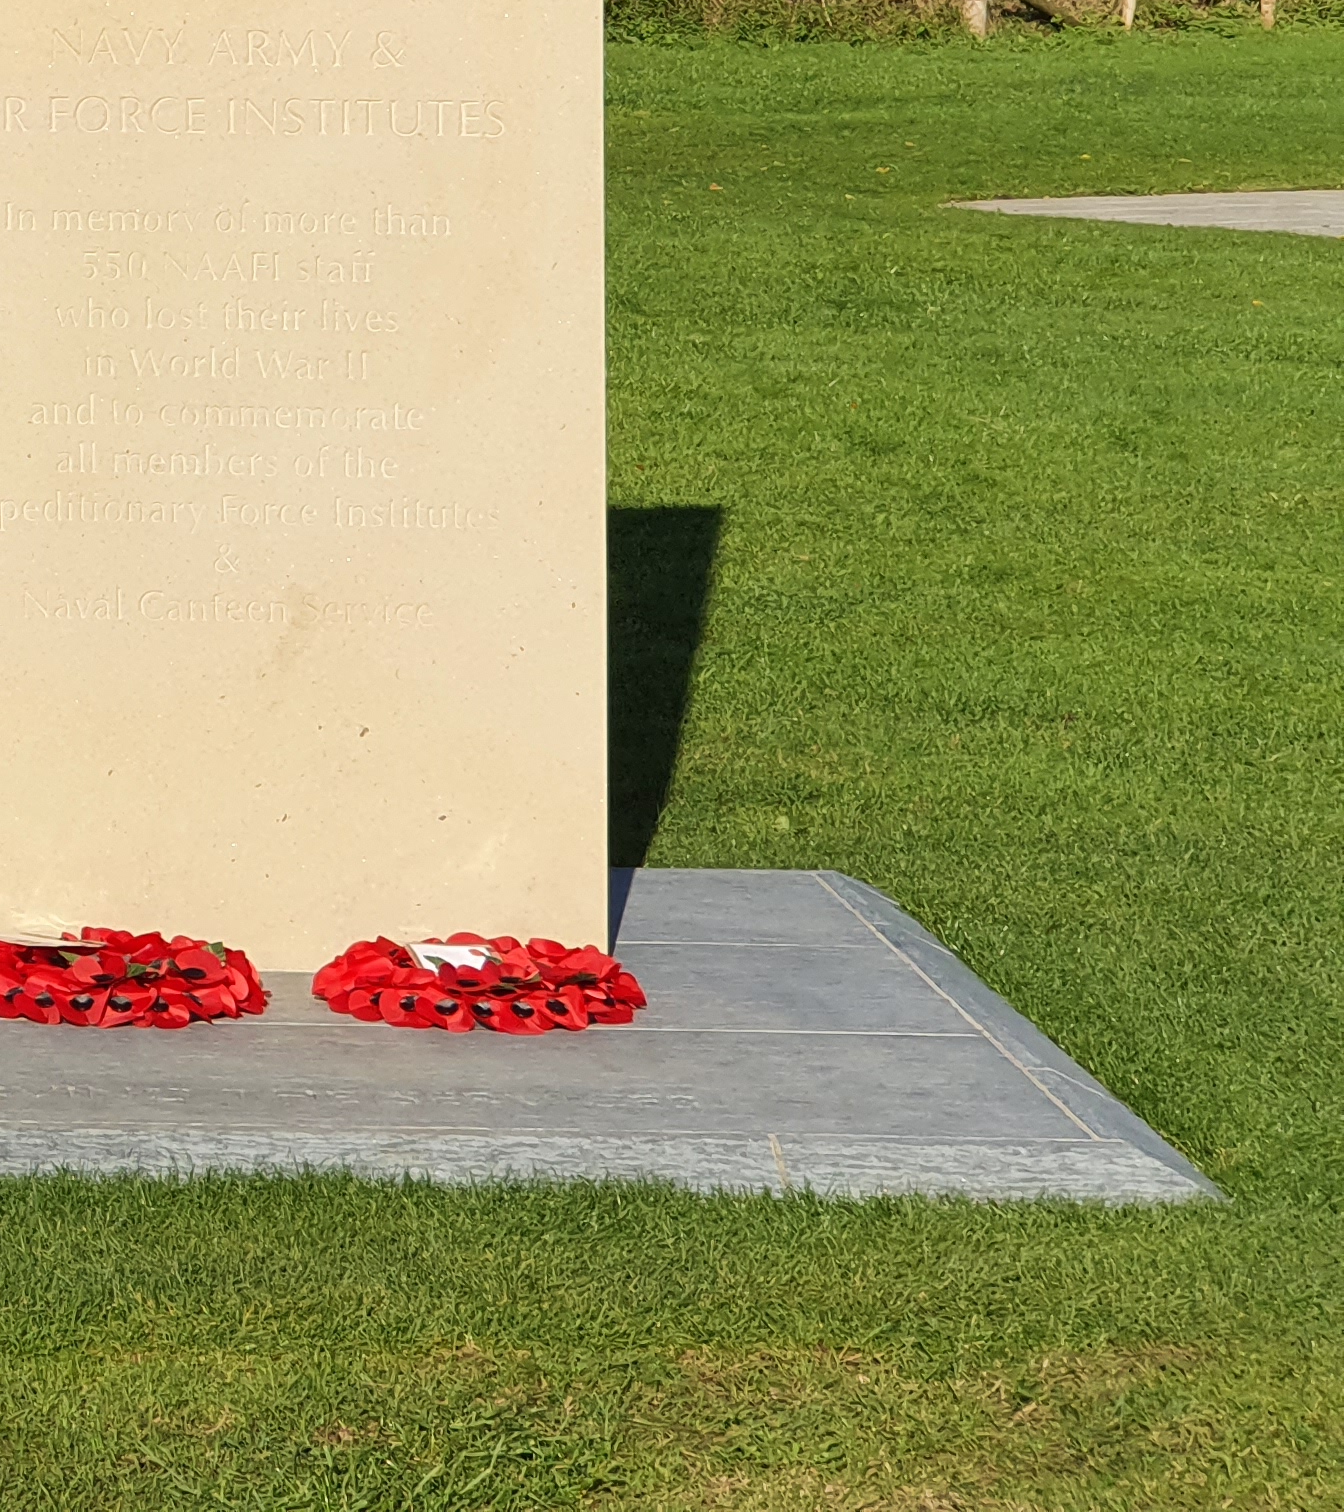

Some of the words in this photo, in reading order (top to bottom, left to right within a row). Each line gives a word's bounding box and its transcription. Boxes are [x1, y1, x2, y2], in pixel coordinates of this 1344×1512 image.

[50, 27, 185, 68] NAVY
[208, 28, 352, 69] ARMY
[370, 29, 405, 69] &
[48, 95, 208, 136] FORCE
[227, 97, 508, 139] INSTITUTES
[3, 200, 38, 233] In
[51, 208, 200, 238] memory
[214, 199, 250, 234] of
[263, 209, 358, 236] more
[372, 203, 452, 238] than
[81, 250, 148, 281] 550
[163, 251, 281, 283] NAAFI
[296, 250, 375, 284] staff
[54, 296, 130, 330] who
[145, 295, 209, 331] lost
[222, 297, 306, 332] their
[321, 298, 400, 334] lives
[83, 349, 115, 378] in
[129, 345, 240, 380] World
[255, 349, 330, 381] War
[344, 349, 370, 381] II
[29, 392, 96, 426] and
[113, 398, 144, 427] to
[159, 400, 425, 431] commemorate
[55, 441, 98, 476] all
[113, 442, 278, 478] members
[293, 444, 332, 480] of
[342, 446, 399, 481] the
[218, 493, 318, 527] Force
[333, 495, 501, 531] Institutes
[213, 543, 240, 575] &
[22, 589, 125, 623] Naval
[138, 589, 289, 624] Canteen
[301, 593, 435, 629] Service
